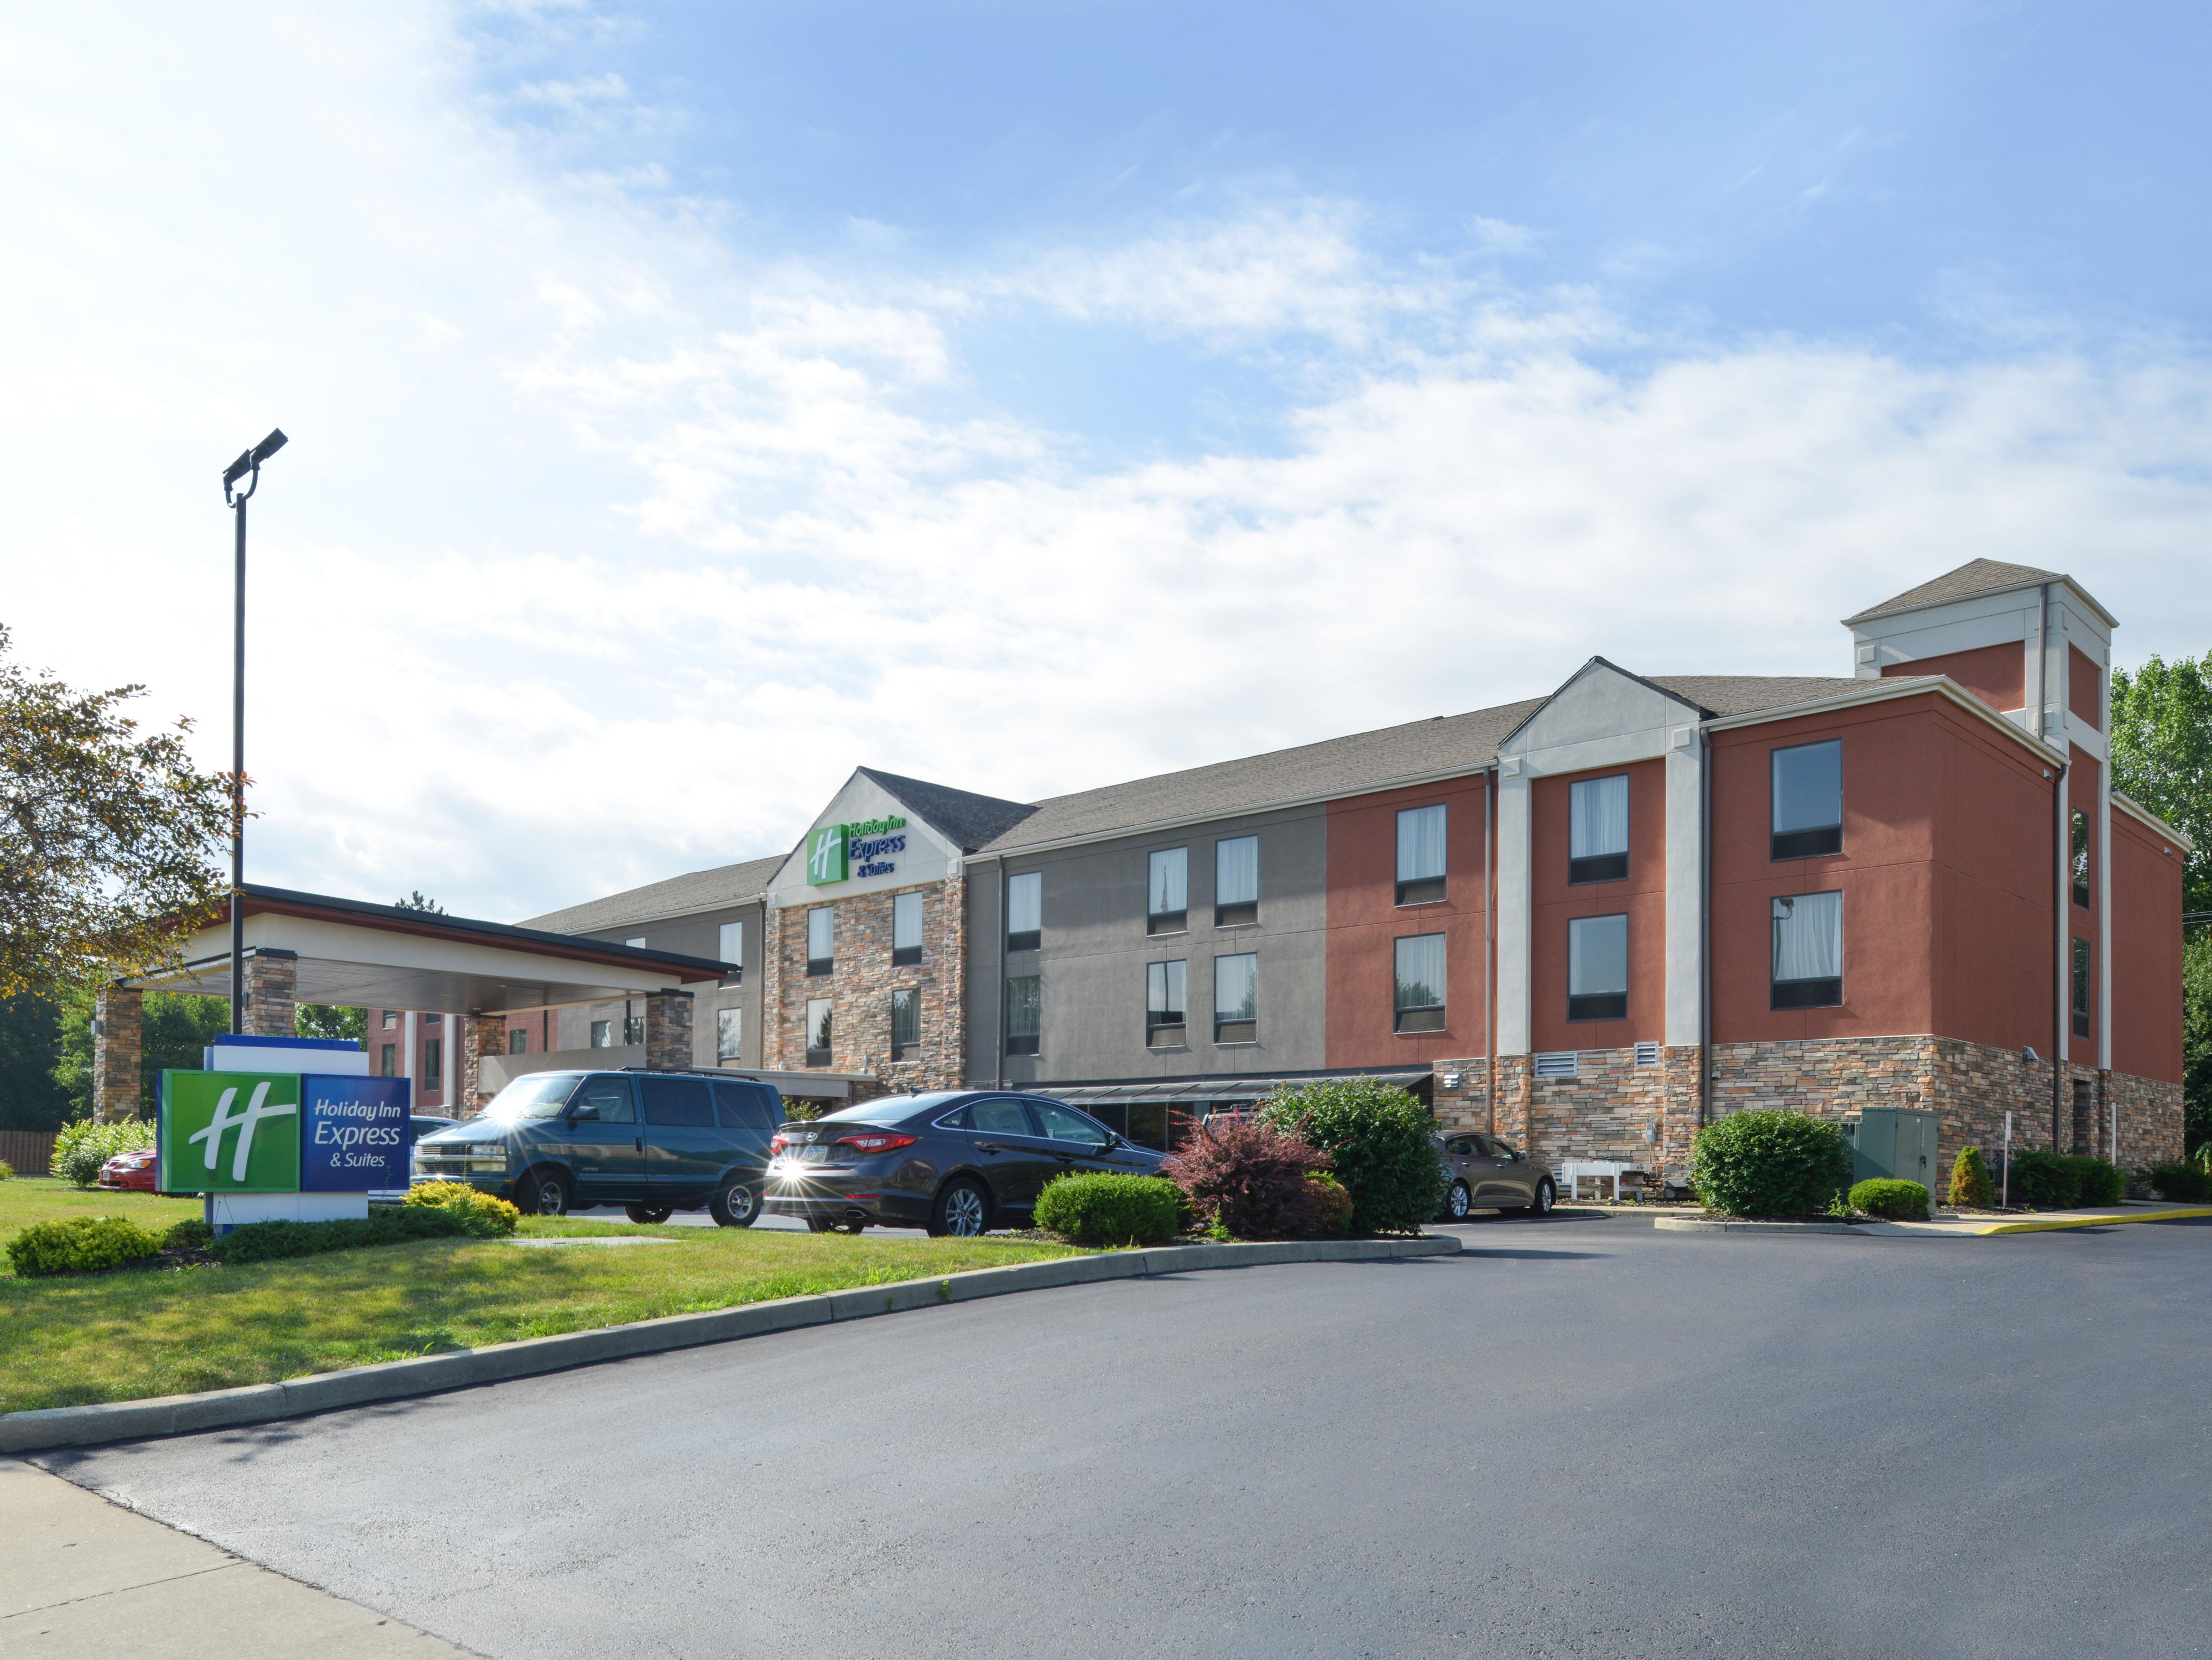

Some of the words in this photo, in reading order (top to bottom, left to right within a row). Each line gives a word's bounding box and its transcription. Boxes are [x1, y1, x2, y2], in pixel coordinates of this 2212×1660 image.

[849, 819, 888, 837] Holiday
[886, 815, 906, 830] Inn
[848, 835, 905, 862] Express
[857, 865, 866, 878] &
[865, 862, 895, 876] Suites
[314, 1099, 377, 1121] Holiday
[379, 1101, 401, 1118] Inn
[314, 1121, 401, 1151] Express
[330, 1152, 341, 1167] &
[344, 1153, 385, 1167] Suites
